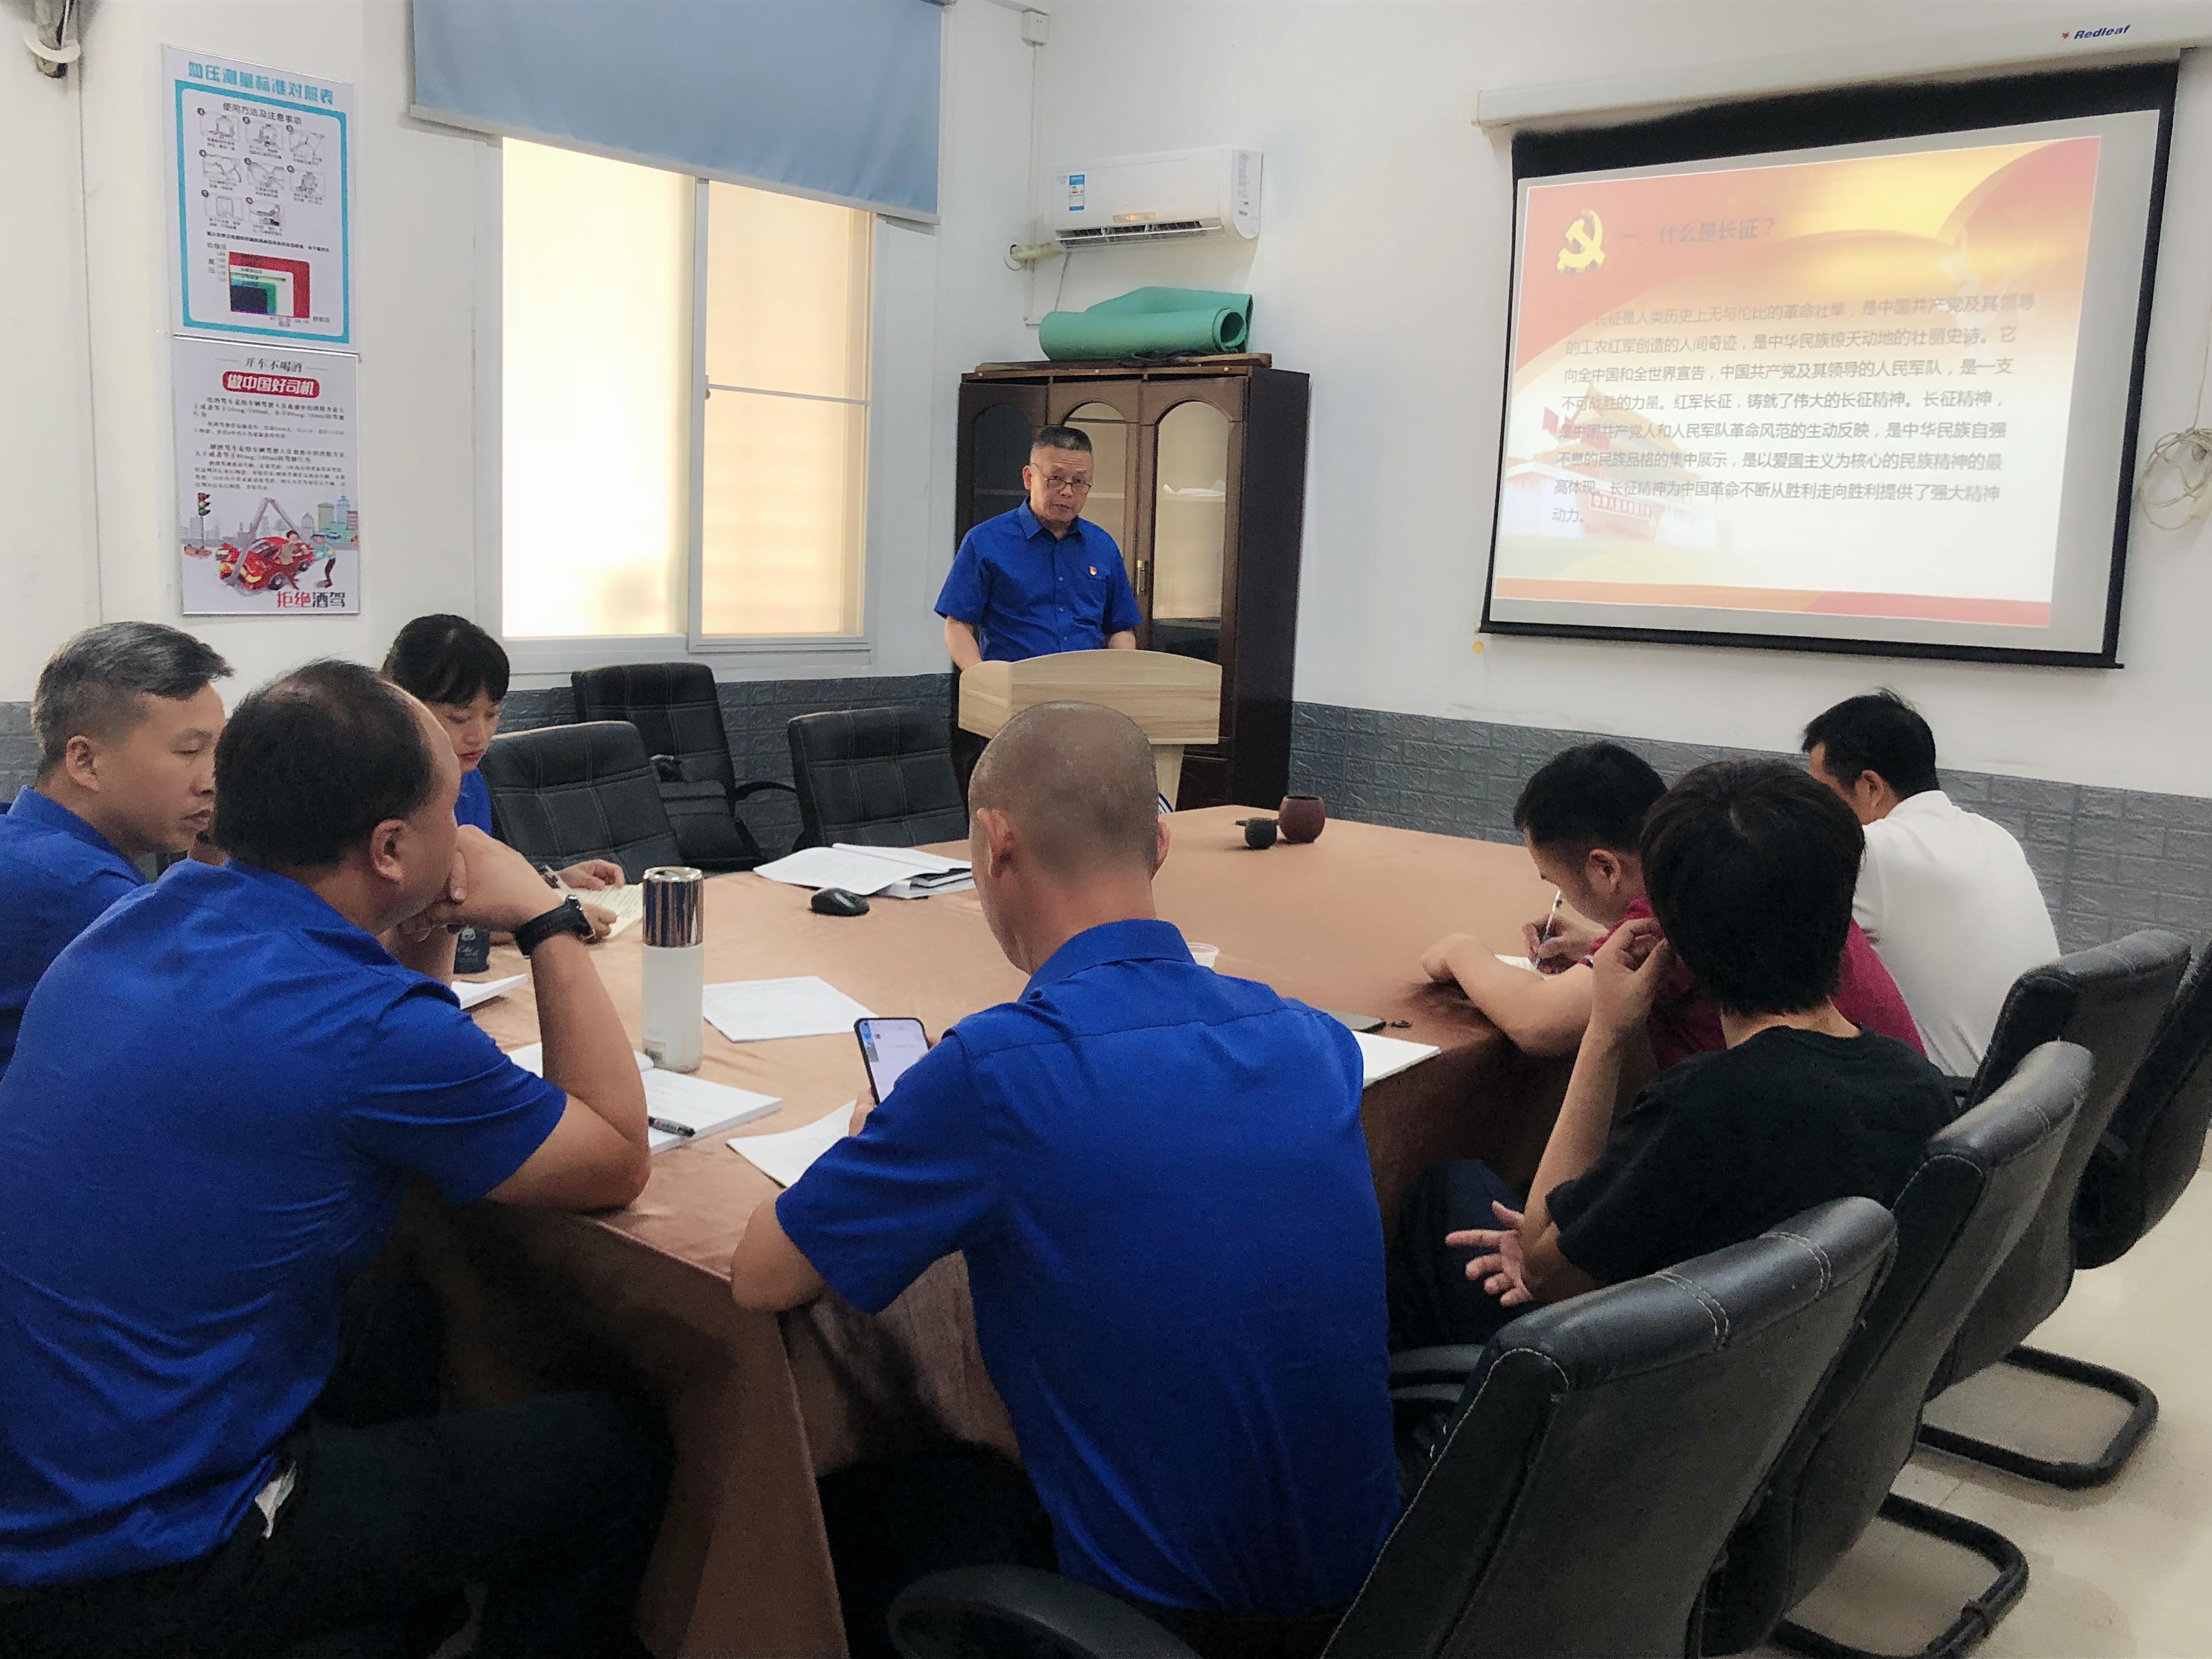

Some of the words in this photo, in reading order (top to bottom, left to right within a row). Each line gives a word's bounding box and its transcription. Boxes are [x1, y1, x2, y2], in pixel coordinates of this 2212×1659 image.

[2074, 24, 2131, 39] Redleaf
[188, 61, 334, 104] 血压测量标准对照表
[223, 102, 302, 125] 使用方法及注意事项
[246, 357, 302, 373] 开车不喝酒
[227, 374, 314, 396] 做中国好司机
[276, 591, 346, 608] 拒绝酒驾
